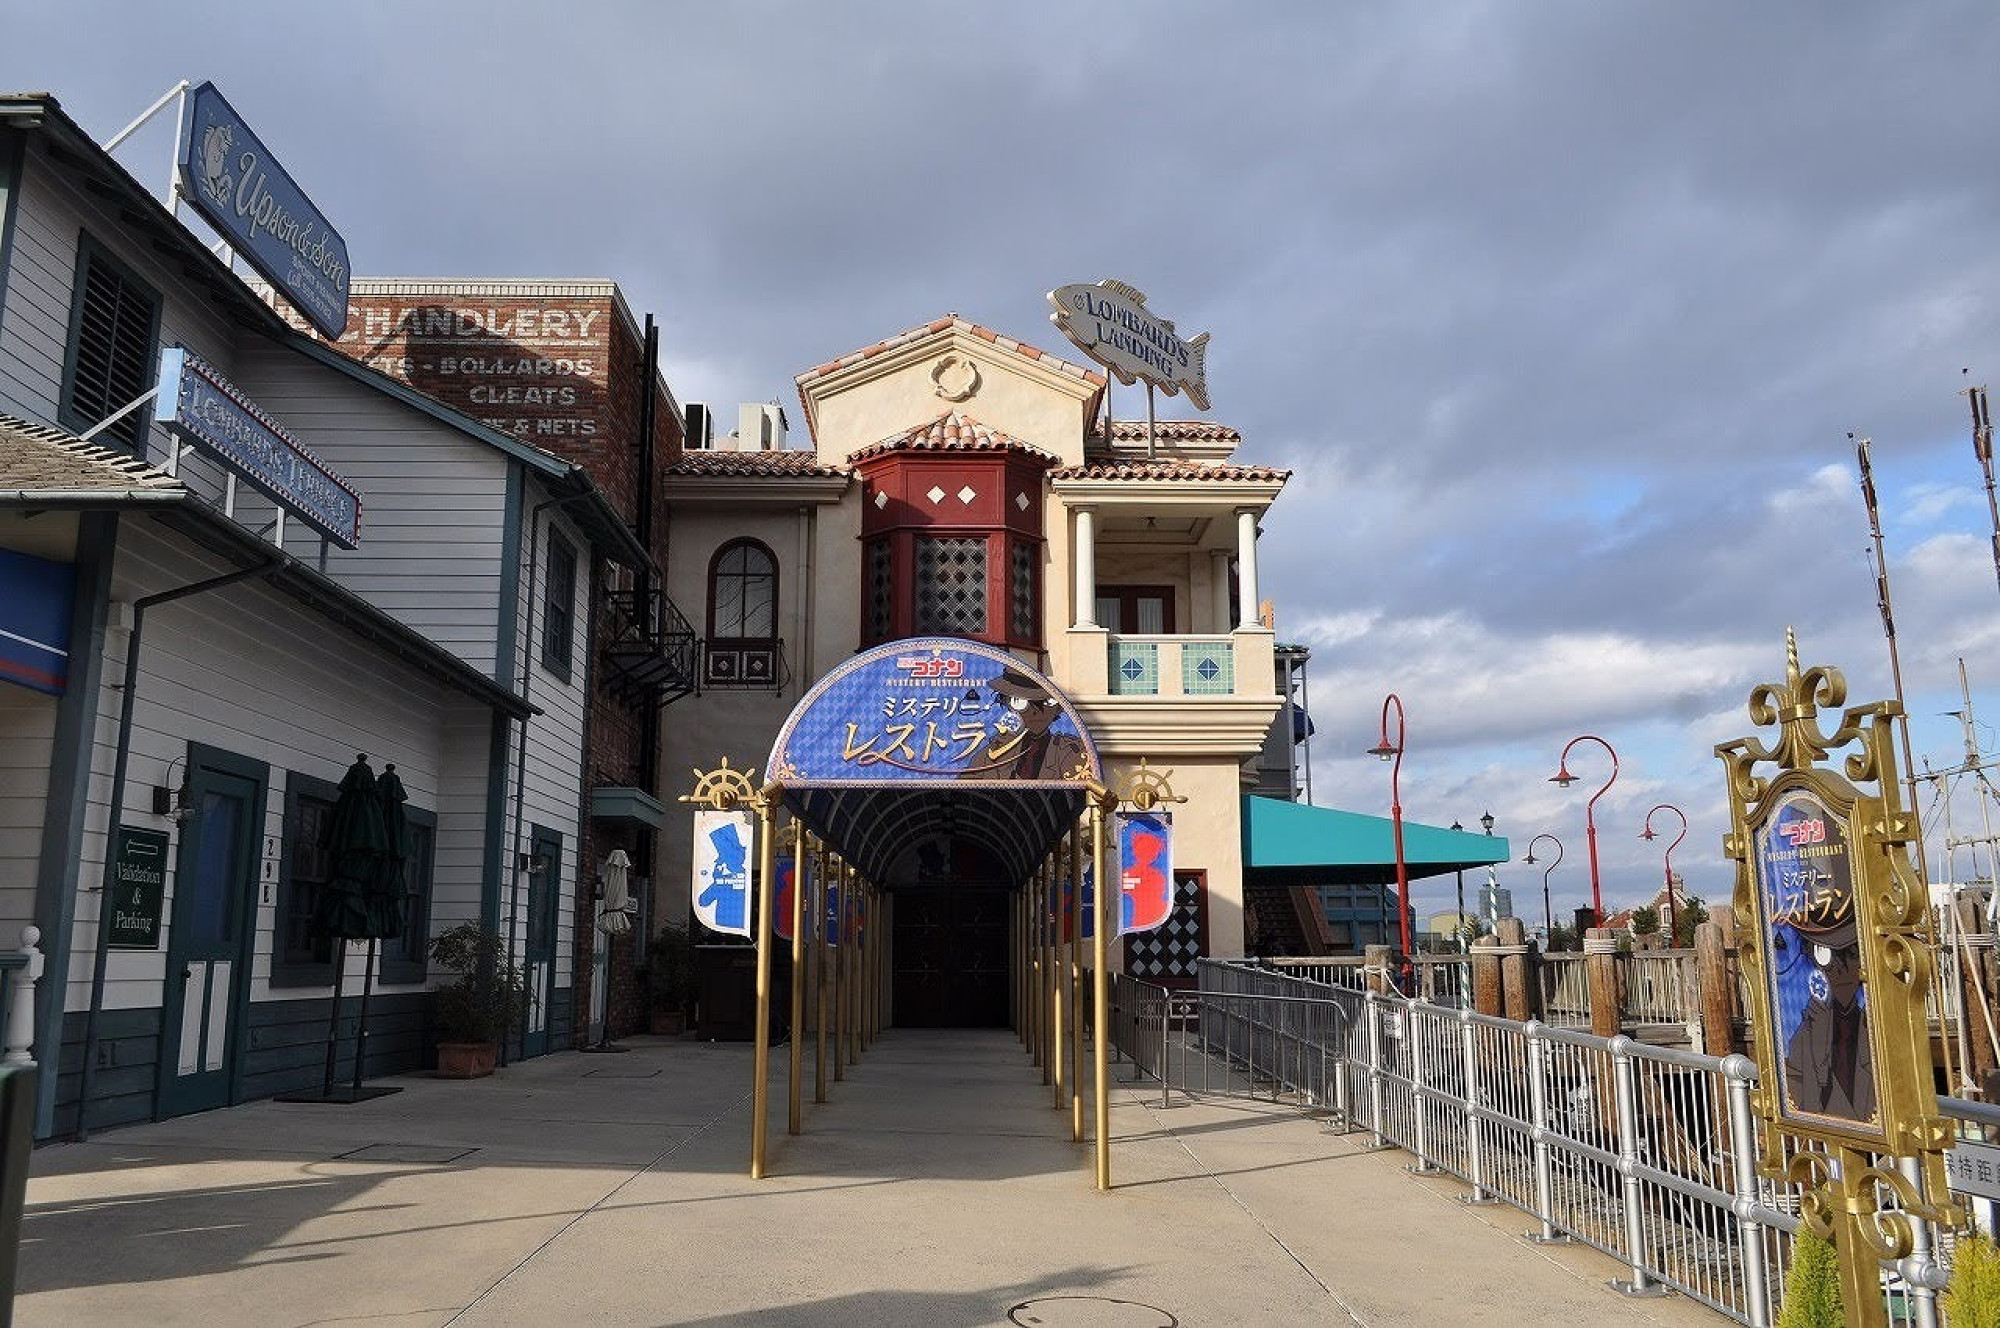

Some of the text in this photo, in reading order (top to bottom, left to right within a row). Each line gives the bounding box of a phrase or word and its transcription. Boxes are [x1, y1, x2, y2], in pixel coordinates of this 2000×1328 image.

[236, 151, 299, 249] Upson
[341, 307, 601, 341] CHANDLERY
[1086, 291, 1189, 367] LOMBARD'S
[1096, 322, 1174, 378] LANDING
[440, 358, 595, 376] BOLLARDS
[470, 386, 576, 406] CLEATS
[537, 418, 597, 435] NETS
[843, 721, 1029, 763] レストラン
[116, 861, 160, 884] Validation
[132, 886, 142, 904] &
[1769, 887, 1853, 923] レストラン
[115, 910, 152, 934] Parking
